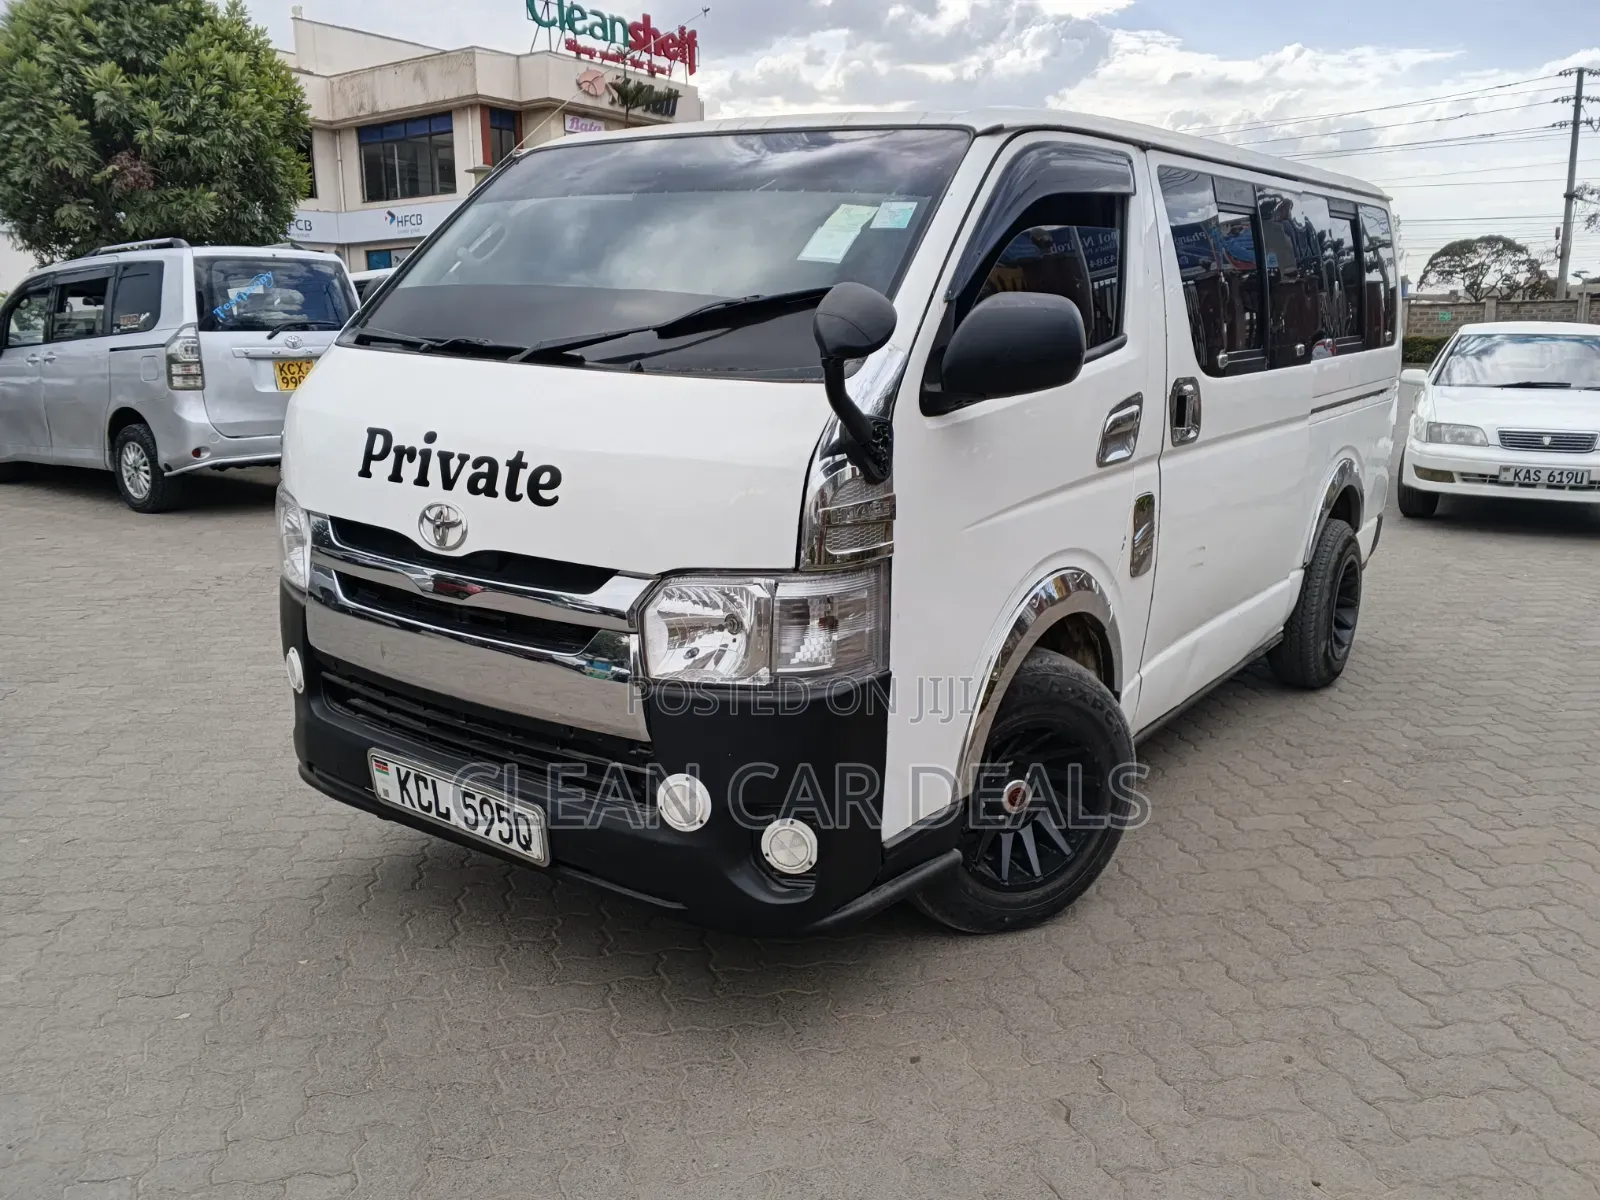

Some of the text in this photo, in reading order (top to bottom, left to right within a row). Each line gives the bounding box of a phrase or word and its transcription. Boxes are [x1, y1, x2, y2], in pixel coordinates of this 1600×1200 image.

[288, 219, 313, 231] FCB
[396, 213, 423, 227] HFCB
[279, 361, 305, 376] KCX
[358, 427, 562, 507] Private
[1513, 467, 1585, 485] KAS 619U
[396, 766, 533, 852] KCL 595Q
